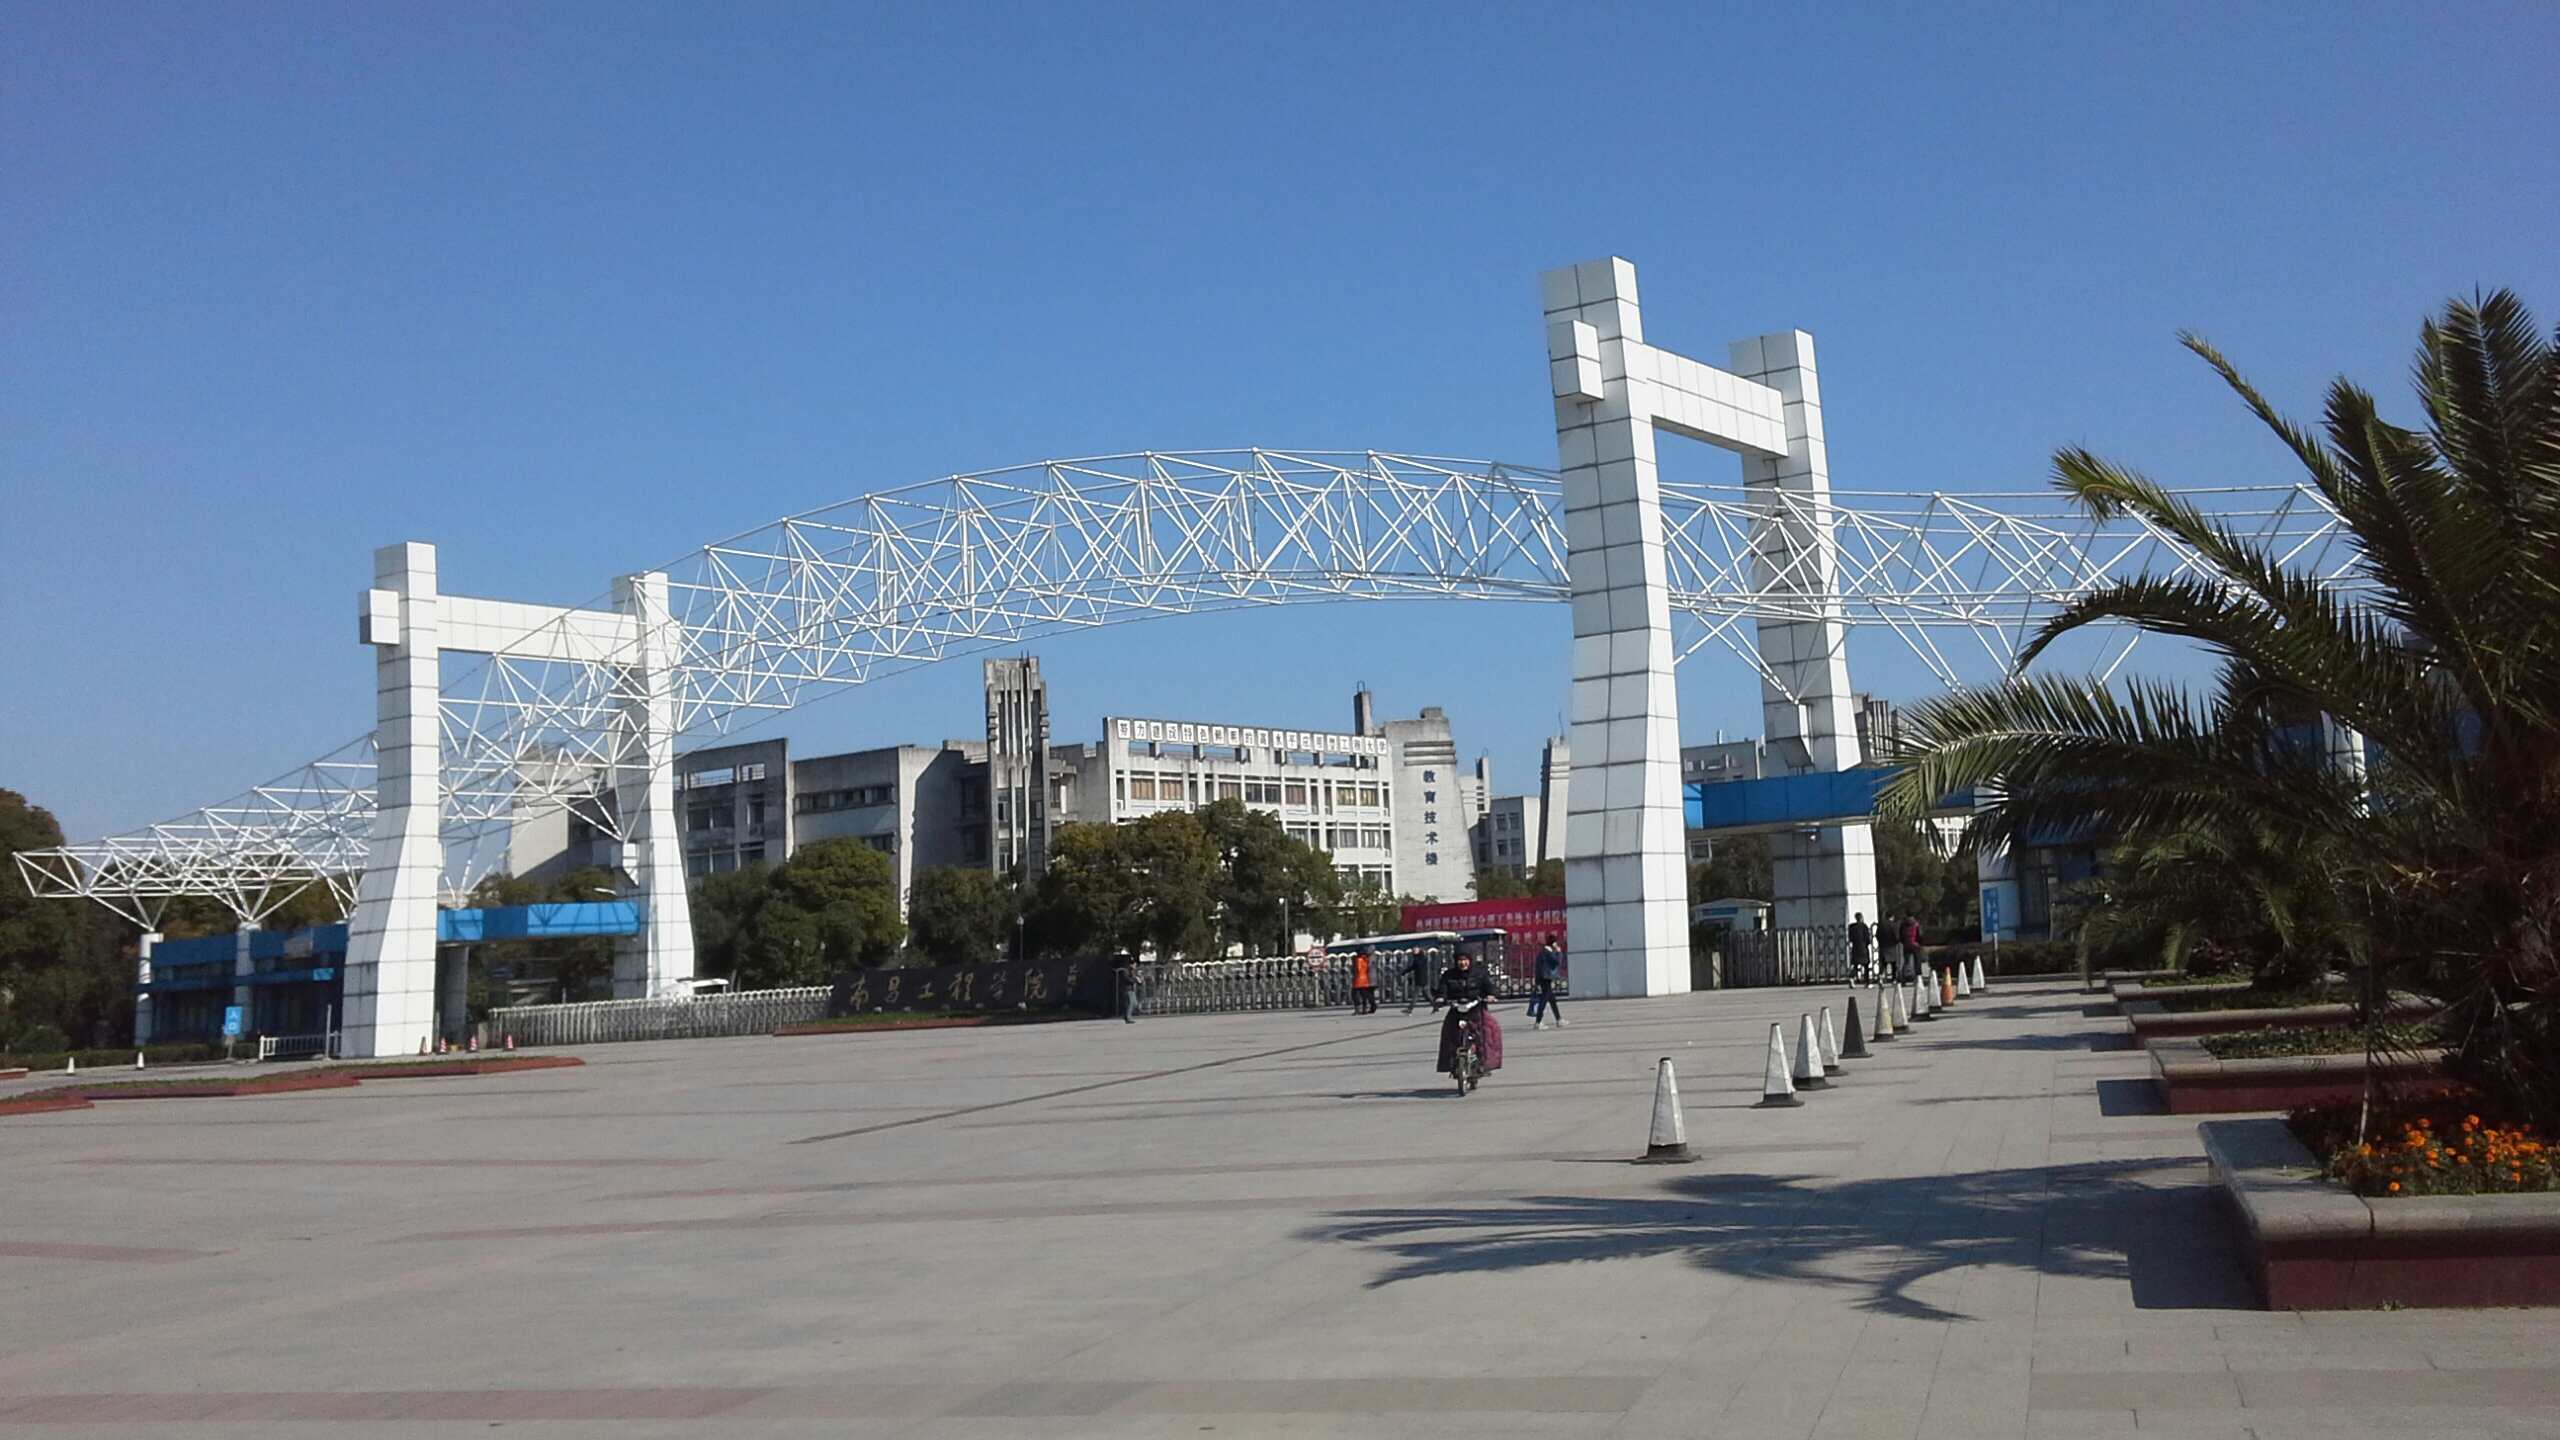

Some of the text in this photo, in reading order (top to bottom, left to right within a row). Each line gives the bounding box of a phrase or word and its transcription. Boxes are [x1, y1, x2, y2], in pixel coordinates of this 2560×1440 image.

[1423, 769, 1438, 866] 教育技术楼
[848, 966, 1047, 1011] 南昌工程学院
